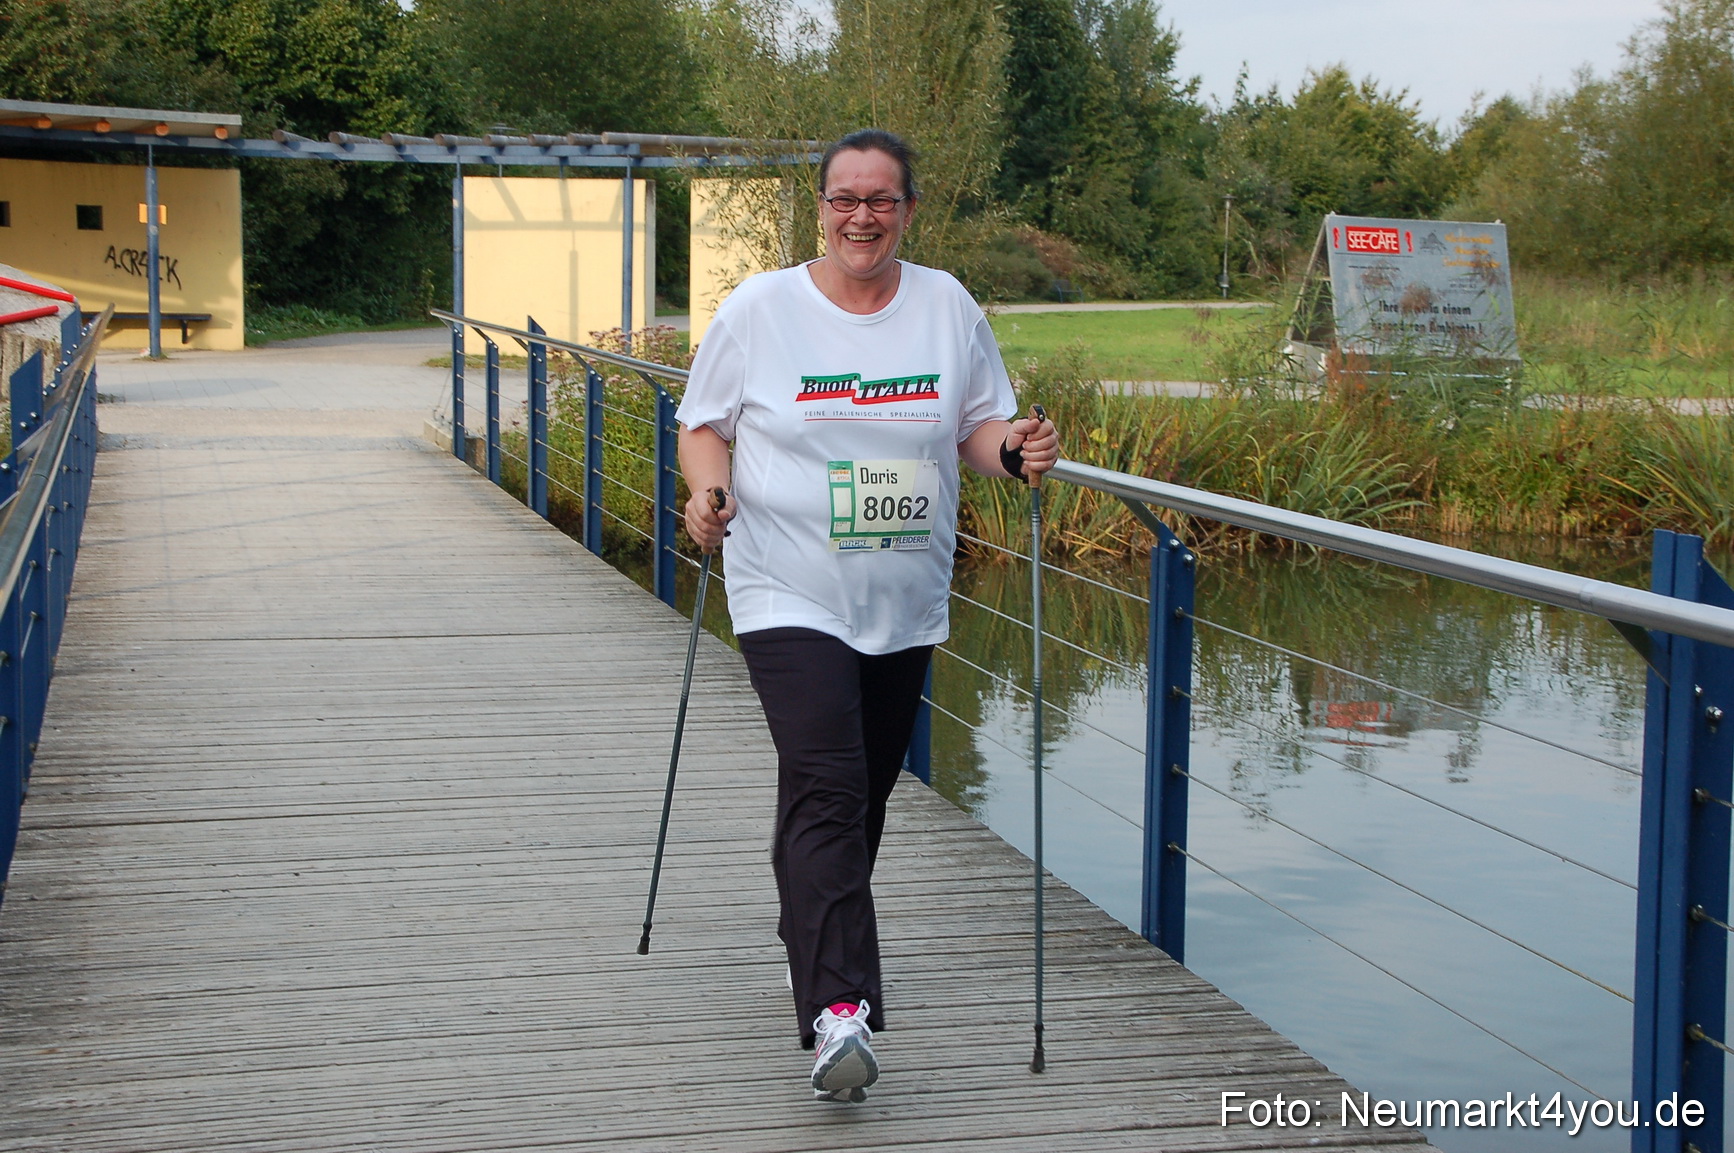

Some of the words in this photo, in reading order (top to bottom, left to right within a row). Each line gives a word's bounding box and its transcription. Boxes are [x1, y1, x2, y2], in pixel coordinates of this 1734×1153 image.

[1442, 303, 1472, 316] einem
[861, 377, 936, 400] ITALIA
[890, 411, 941, 419] SPEZIALITÄTEN
[860, 467, 898, 485] Doris
[863, 496, 930, 521] 8062
[892, 536, 930, 544] PFLEIDERER
